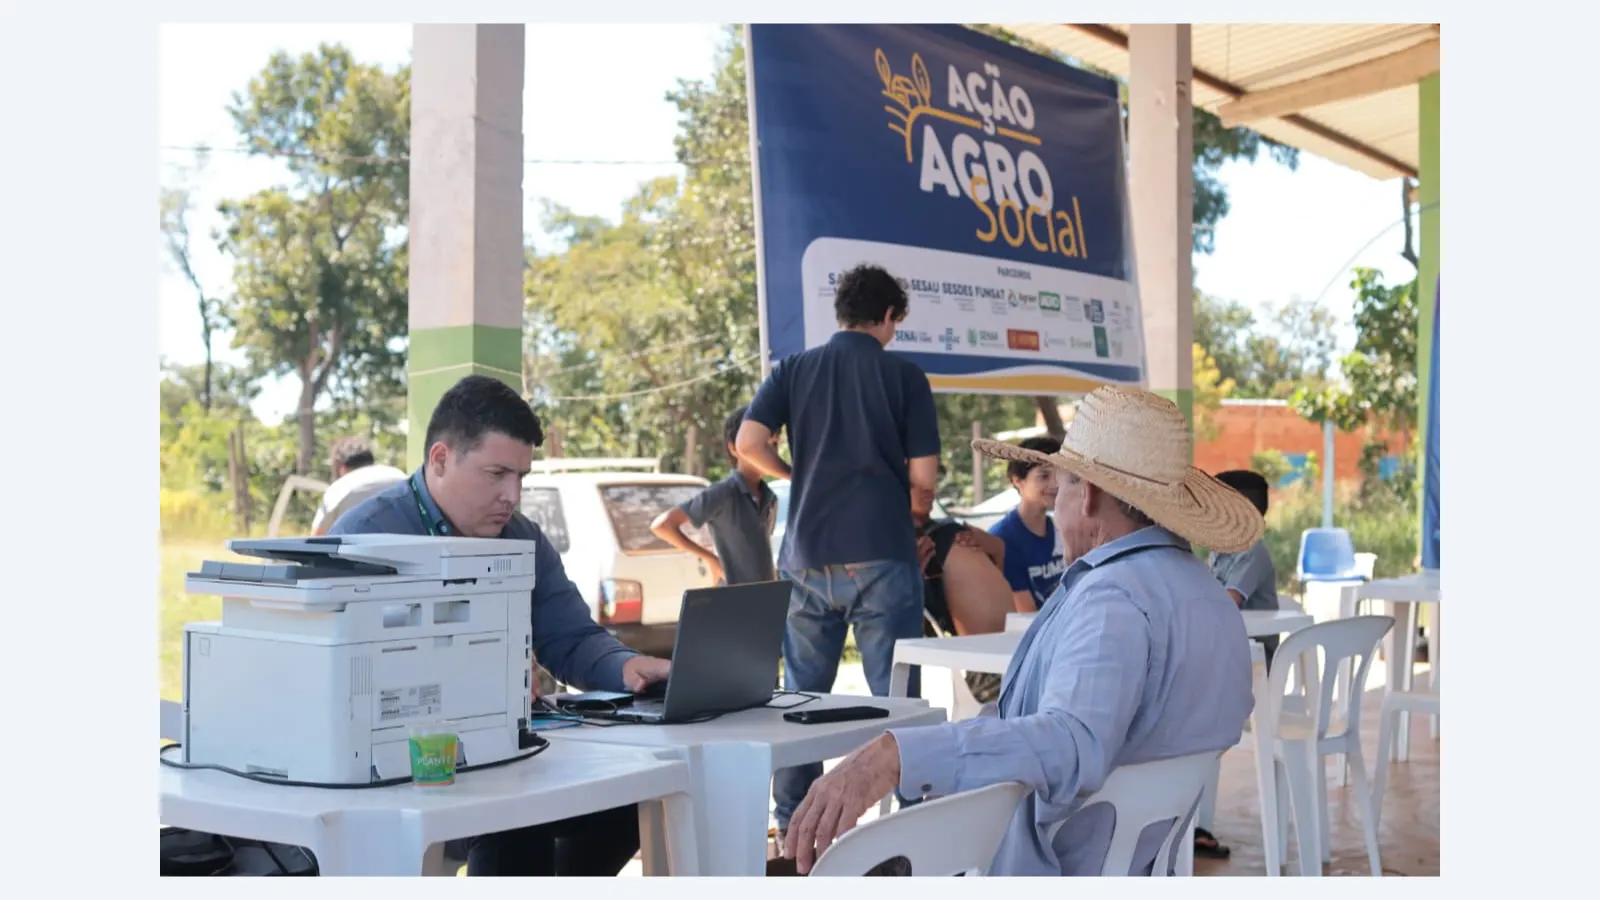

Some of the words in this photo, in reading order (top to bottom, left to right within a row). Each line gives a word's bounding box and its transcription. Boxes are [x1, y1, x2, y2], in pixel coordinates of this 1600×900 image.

[948, 61, 1035, 135] AÇÃO
[920, 124, 1054, 216] AGRO
[970, 175, 1087, 259] Social
